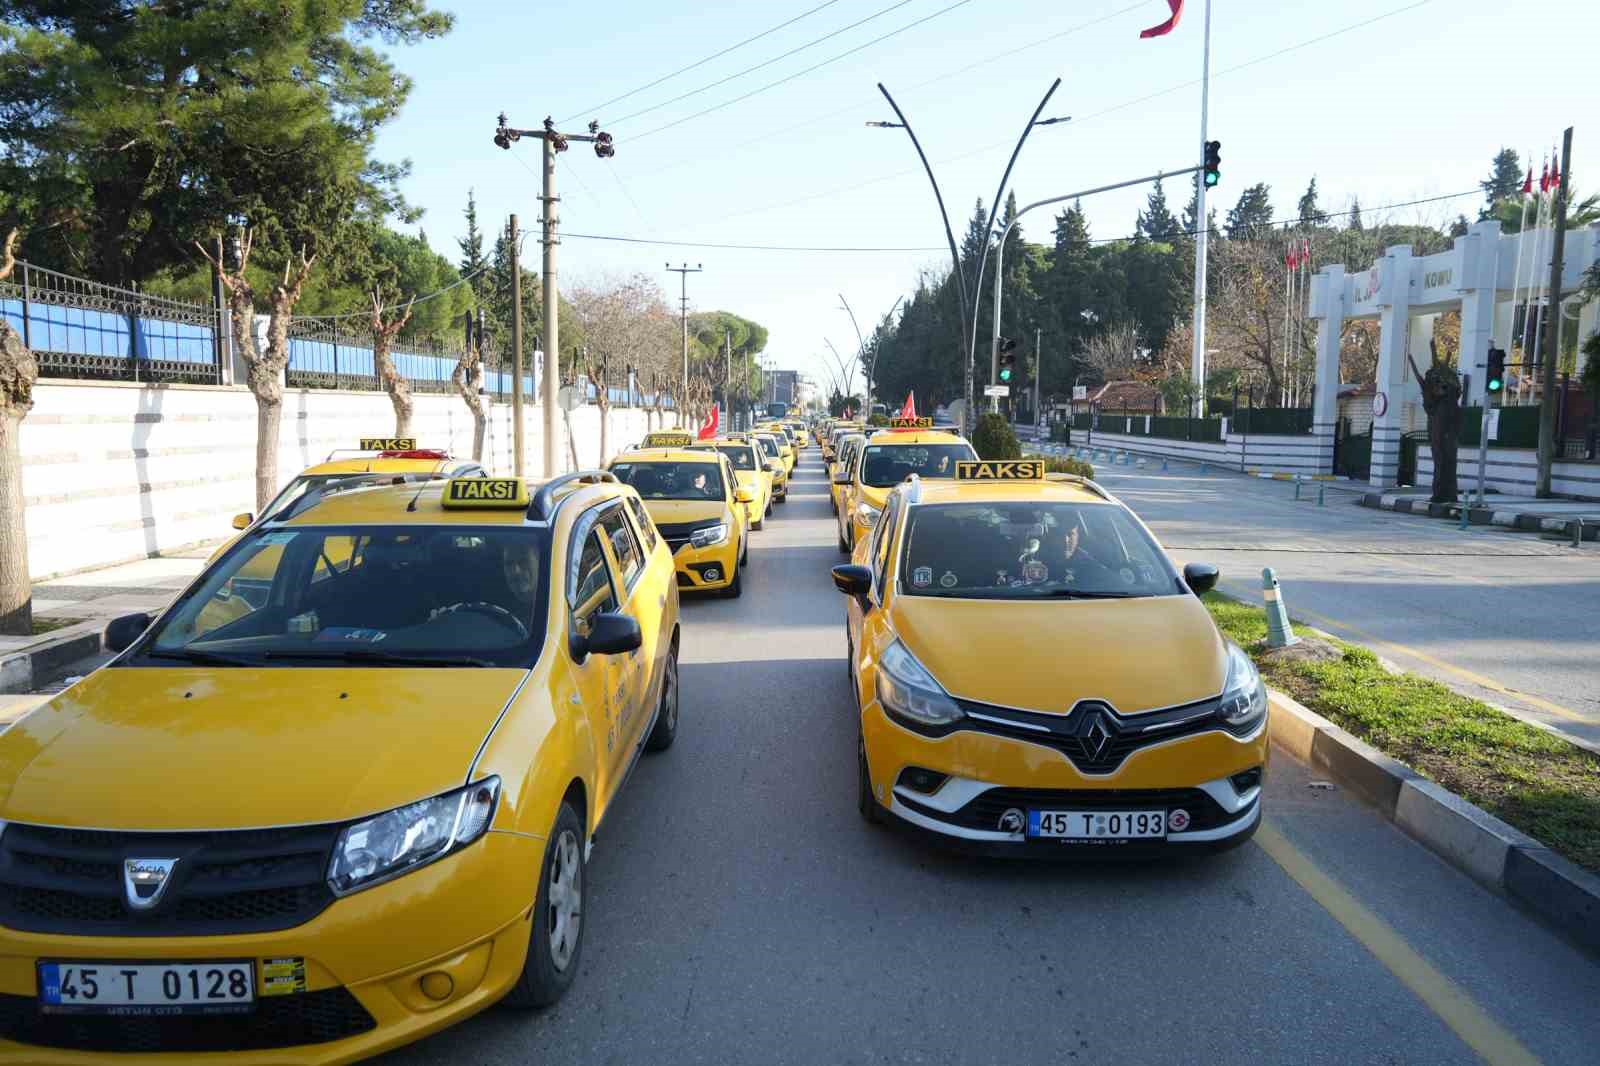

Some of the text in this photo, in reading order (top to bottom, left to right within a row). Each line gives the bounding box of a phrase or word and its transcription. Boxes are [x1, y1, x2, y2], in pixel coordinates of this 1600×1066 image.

[1041, 814, 1067, 834] 45
[1082, 814, 1095, 835] T
[1108, 814, 1162, 835] 0193
[129, 864, 165, 873] DACIA
[60, 969, 98, 999] 45
[120, 970, 138, 1000] T
[163, 968, 248, 1000] 0128
